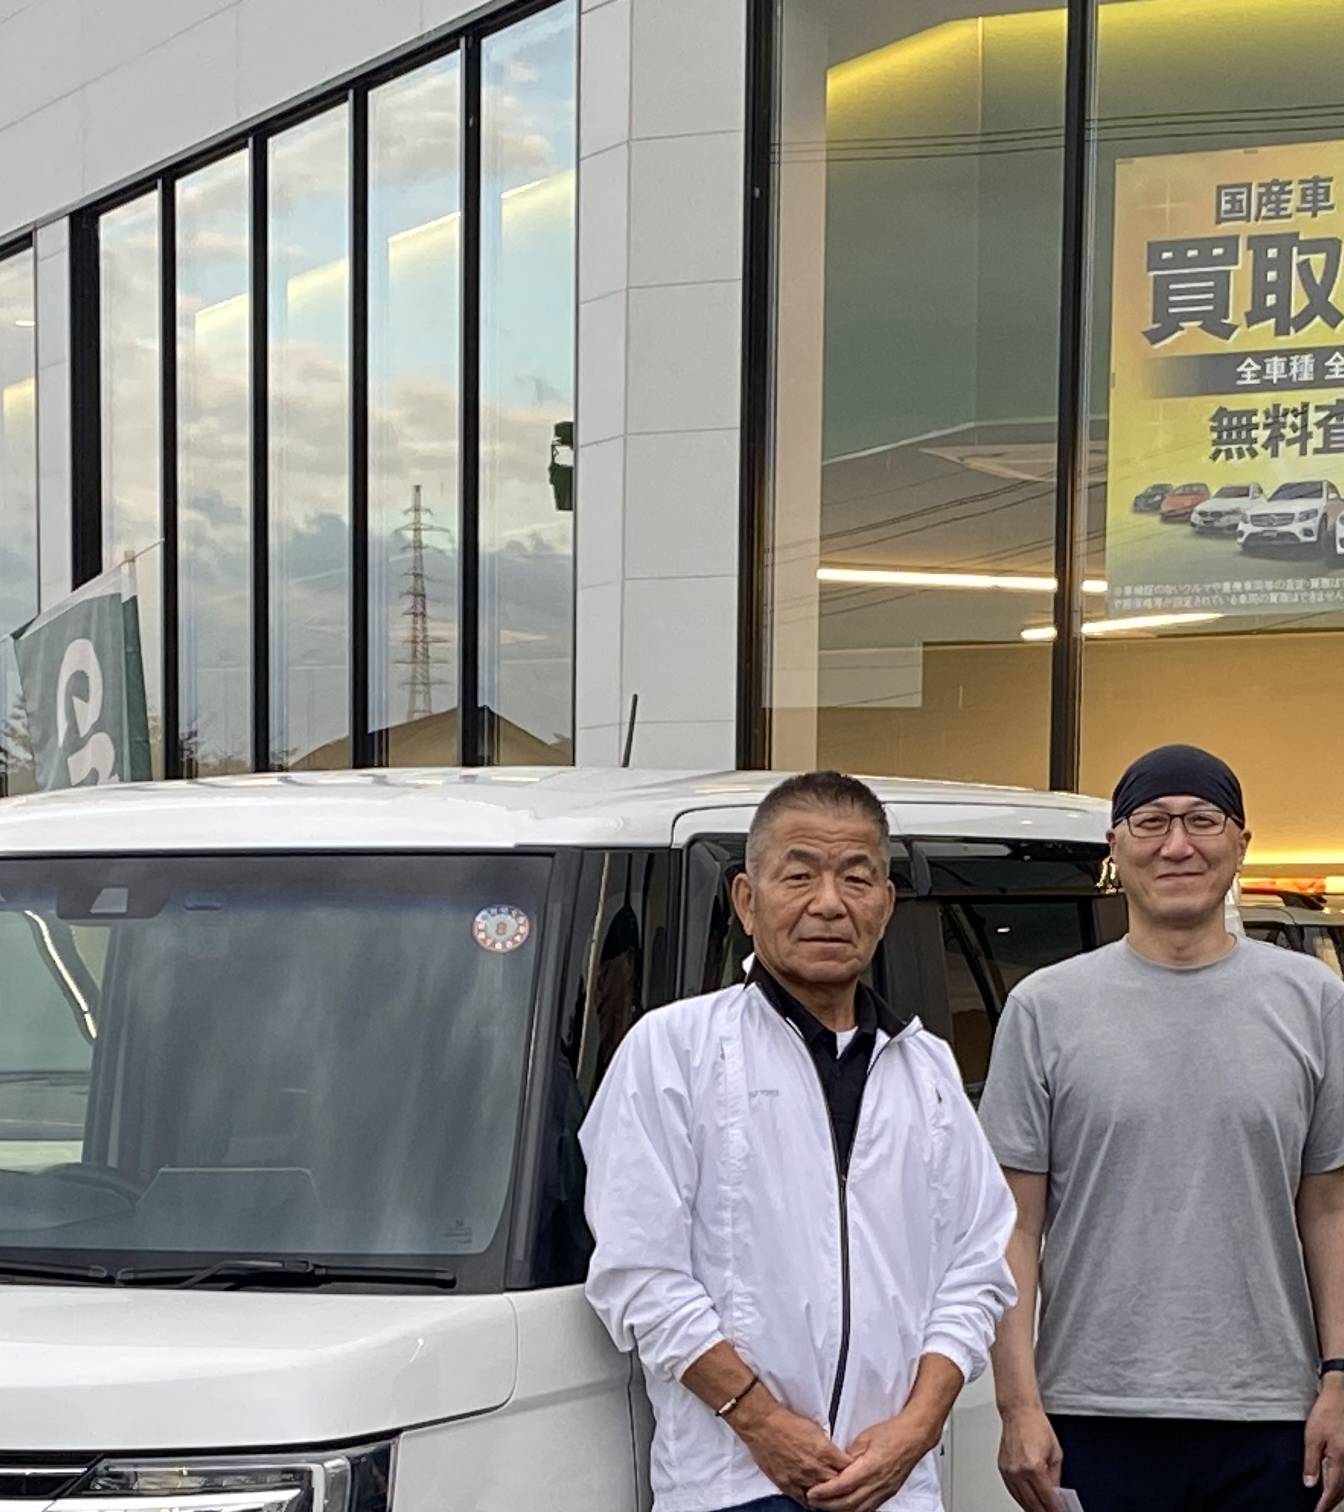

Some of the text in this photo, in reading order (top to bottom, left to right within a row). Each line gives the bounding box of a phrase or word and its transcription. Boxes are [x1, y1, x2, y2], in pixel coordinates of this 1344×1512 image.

[1215, 174, 1335, 225] 国産車
[1235, 352, 1315, 386] 全車種
